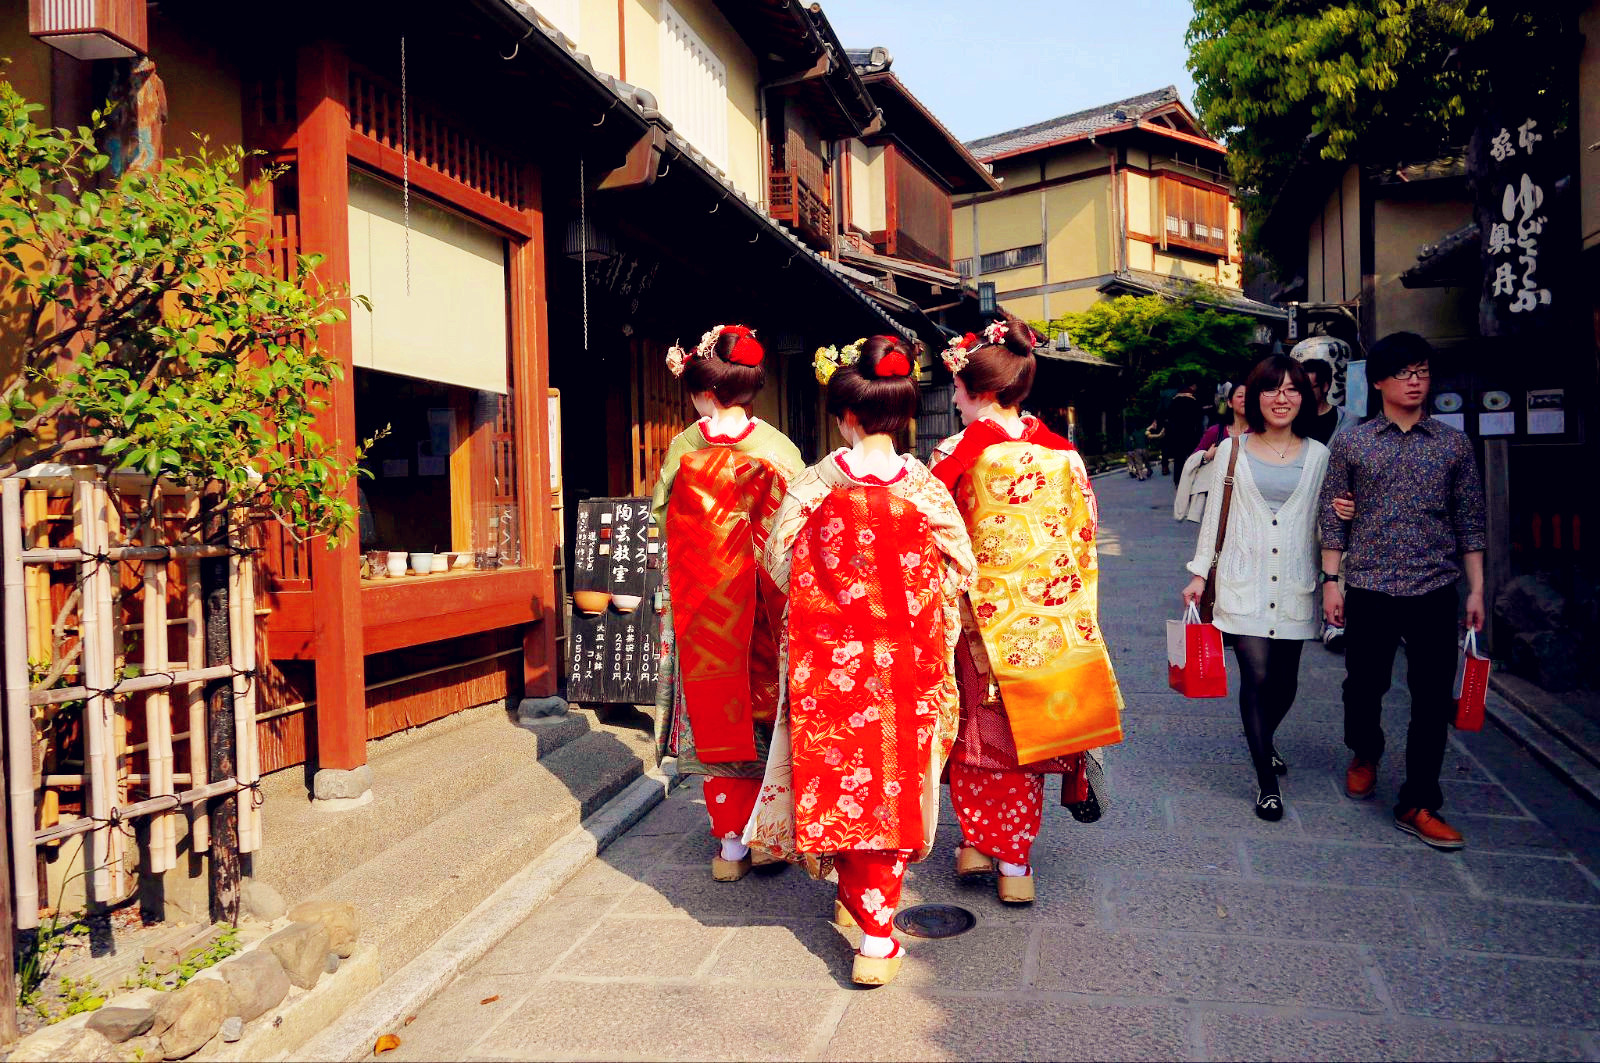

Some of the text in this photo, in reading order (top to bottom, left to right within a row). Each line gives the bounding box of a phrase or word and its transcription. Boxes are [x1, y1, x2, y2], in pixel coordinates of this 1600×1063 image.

[612, 503, 633, 583] 陶芸教室
[635, 505, 650, 574] ろくろの
[571, 634, 583, 682] 3500円
[584, 651, 595, 679] コース
[612, 633, 623, 681] 2200円
[624, 625, 635, 681] お茶碗コース
[641, 634, 650, 682] 1800円
